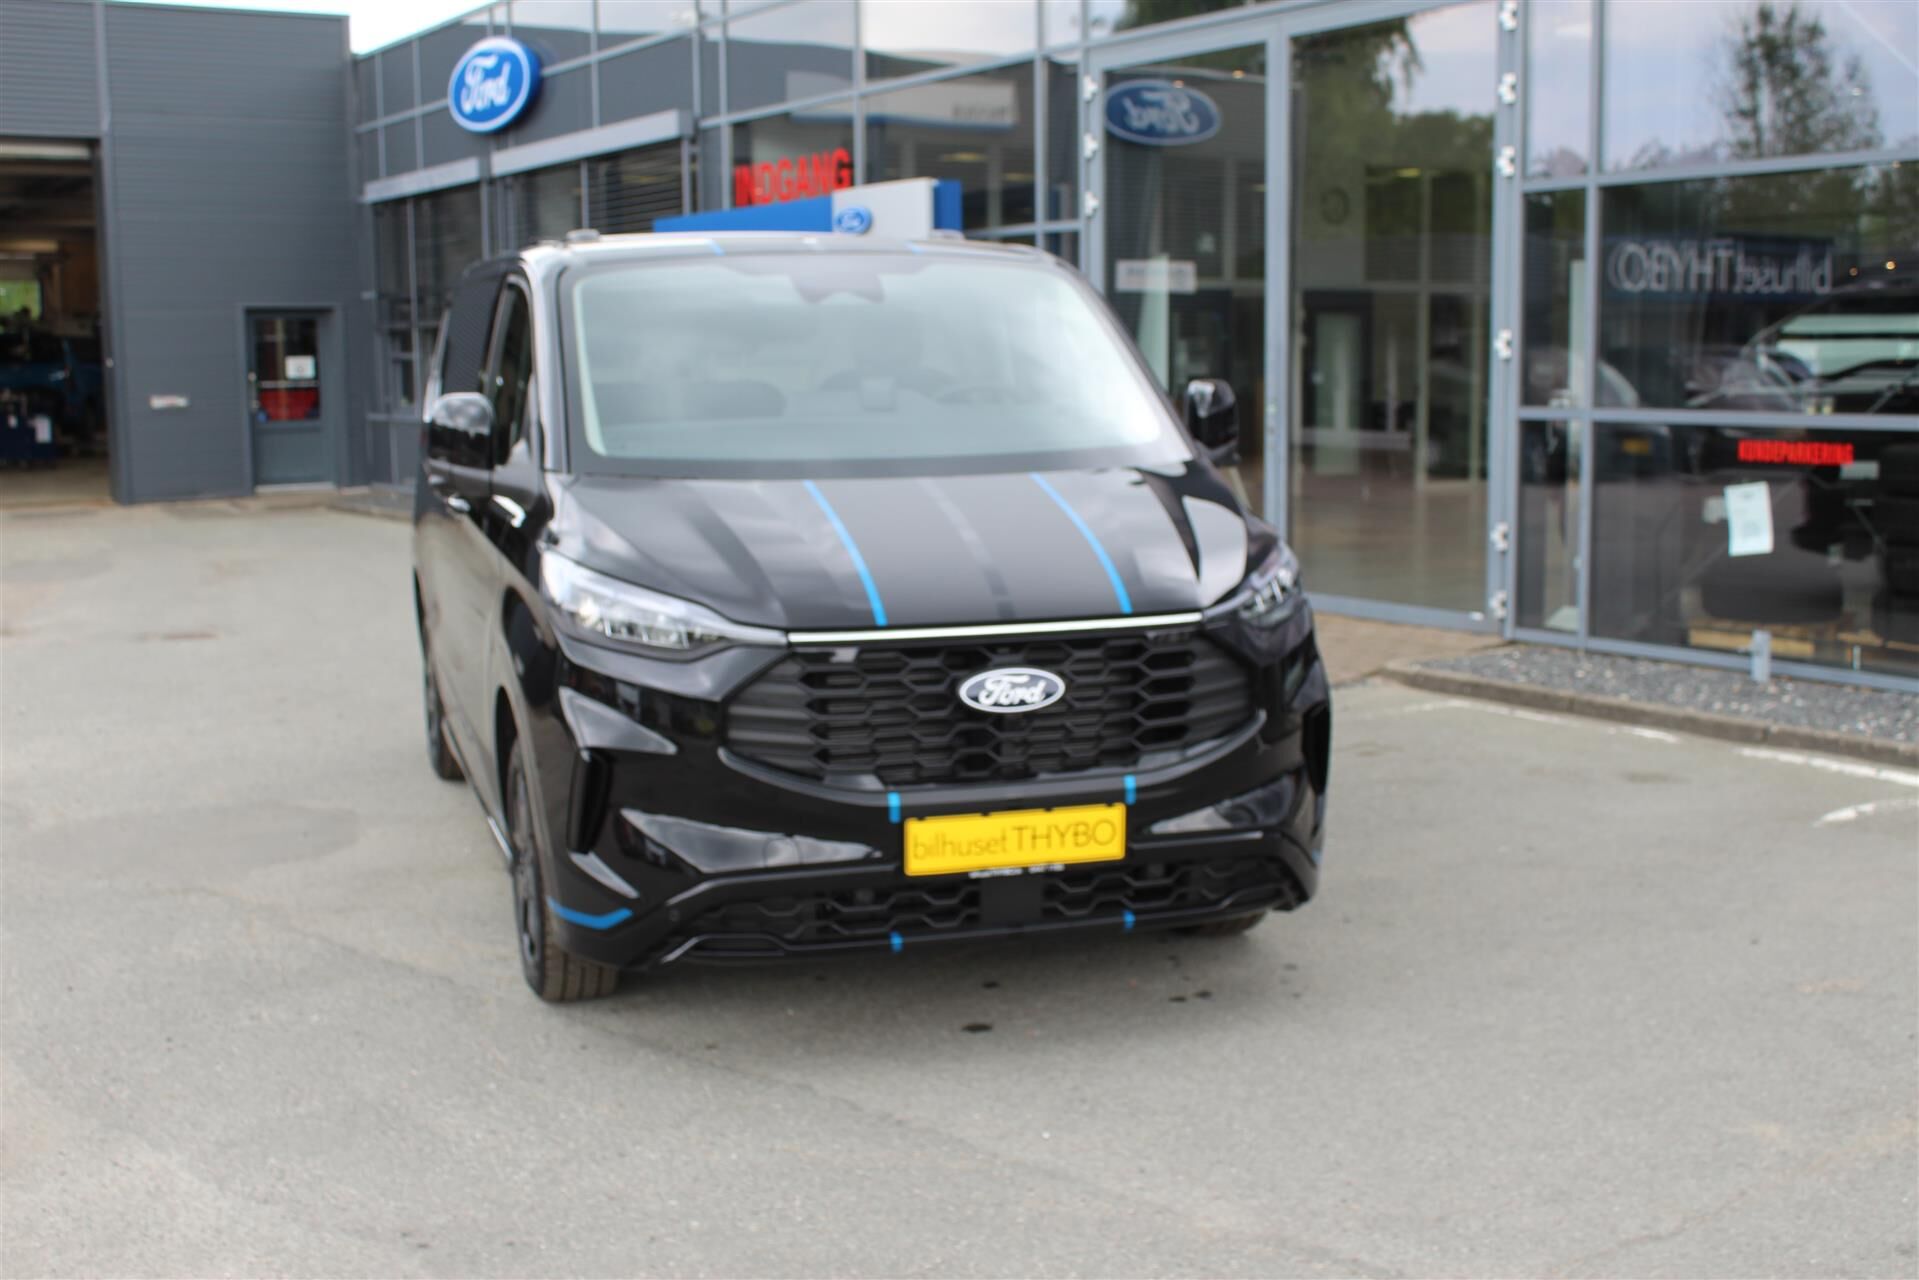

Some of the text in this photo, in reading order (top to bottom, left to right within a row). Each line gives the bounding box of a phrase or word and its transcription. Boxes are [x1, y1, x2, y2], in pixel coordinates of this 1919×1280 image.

[460, 54, 511, 114] Ford
[979, 675, 1046, 705] Ford
[912, 819, 1117, 860] bilhuset THYBO
